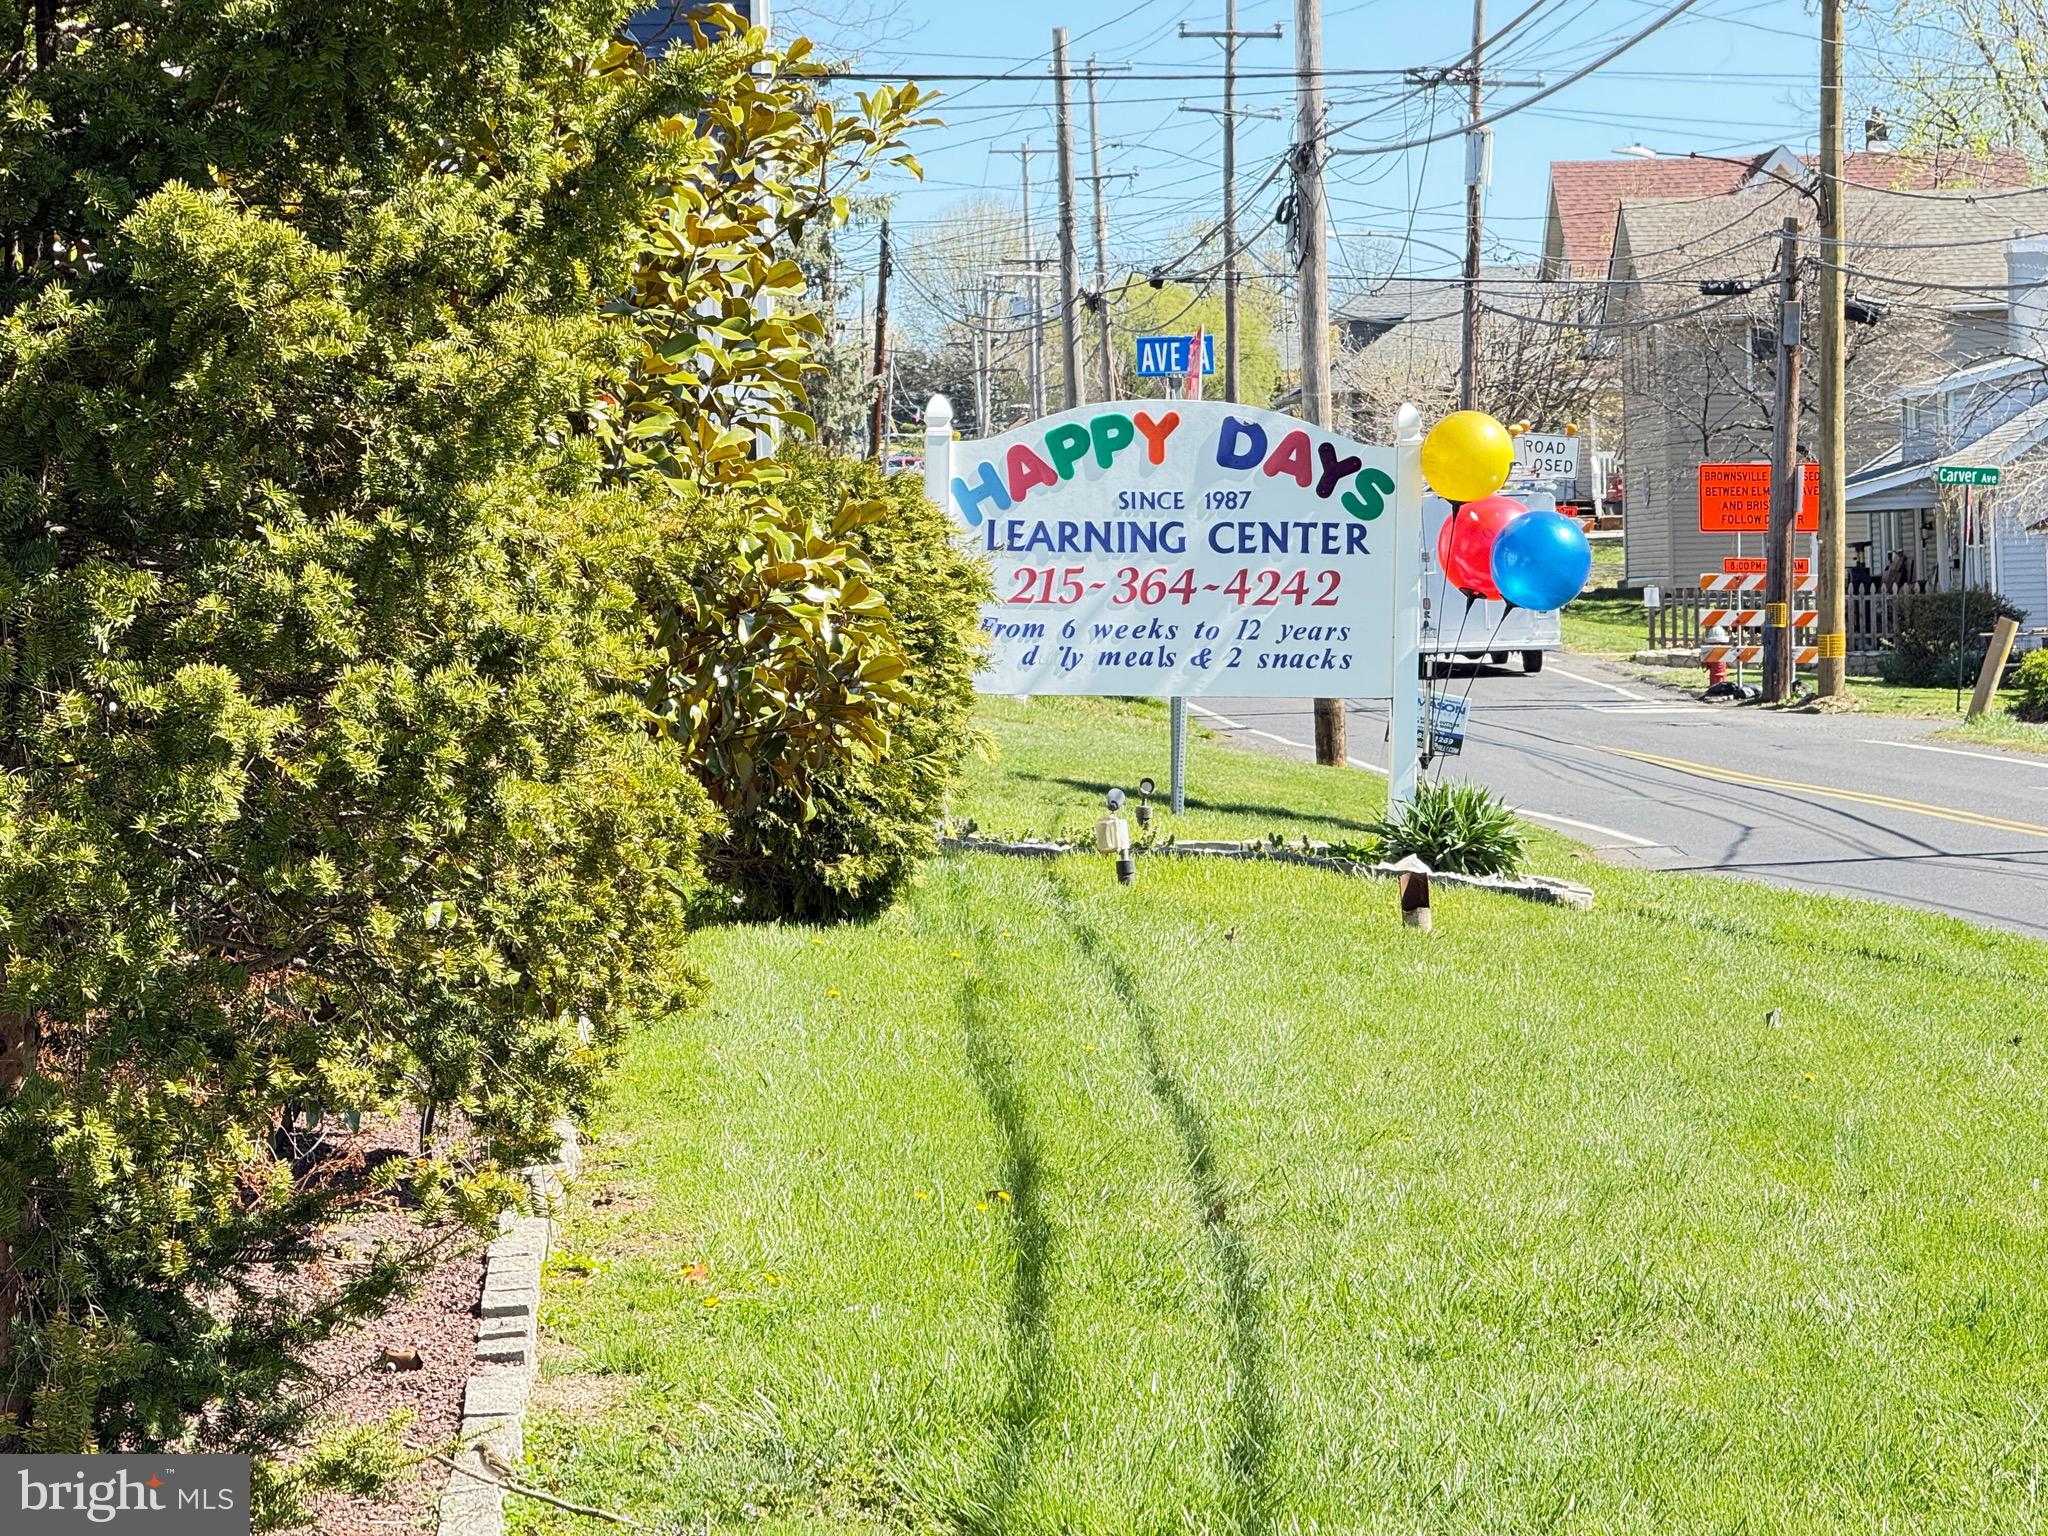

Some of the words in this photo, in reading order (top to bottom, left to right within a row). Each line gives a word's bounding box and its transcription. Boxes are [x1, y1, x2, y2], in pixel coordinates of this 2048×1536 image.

[1142, 342, 1181, 372] AVE
[1525, 440, 1566, 455] ROAD
[950, 411, 1181, 527] HAPPY
[1216, 415, 1396, 521] DAYS
[1533, 458, 1573, 473] OSED
[1704, 471, 1767, 482] BROWNSVILLE
[1803, 471, 1819, 481] SED
[1940, 468, 1977, 483] Carver
[1981, 473, 1997, 484] Ave
[1705, 486, 1749, 497] BETWEEN
[1751, 487, 1770, 497] ELM
[1118, 491, 1185, 510] SINCE
[1204, 490, 1252, 510] 1987
[1721, 500, 1744, 511] AND
[1746, 500, 1770, 511] BRIS
[1721, 514, 1762, 525] FOLLOW
[986, 519, 1186, 554] LEARNING
[1208, 521, 1371, 555] CENTER
[980, 616, 1045, 639] From
[1061, 618, 1076, 639] 6
[1094, 617, 1179, 640] weeks
[1193, 620, 1220, 640] to
[1235, 619, 1262, 641] 12
[1275, 624, 1351, 644] years
[1022, 645, 1084, 671] dly
[1098, 645, 1177, 668] meals
[1190, 647, 1213, 669] &
[1226, 647, 1242, 668] 2
[1256, 648, 1353, 670] snacks
